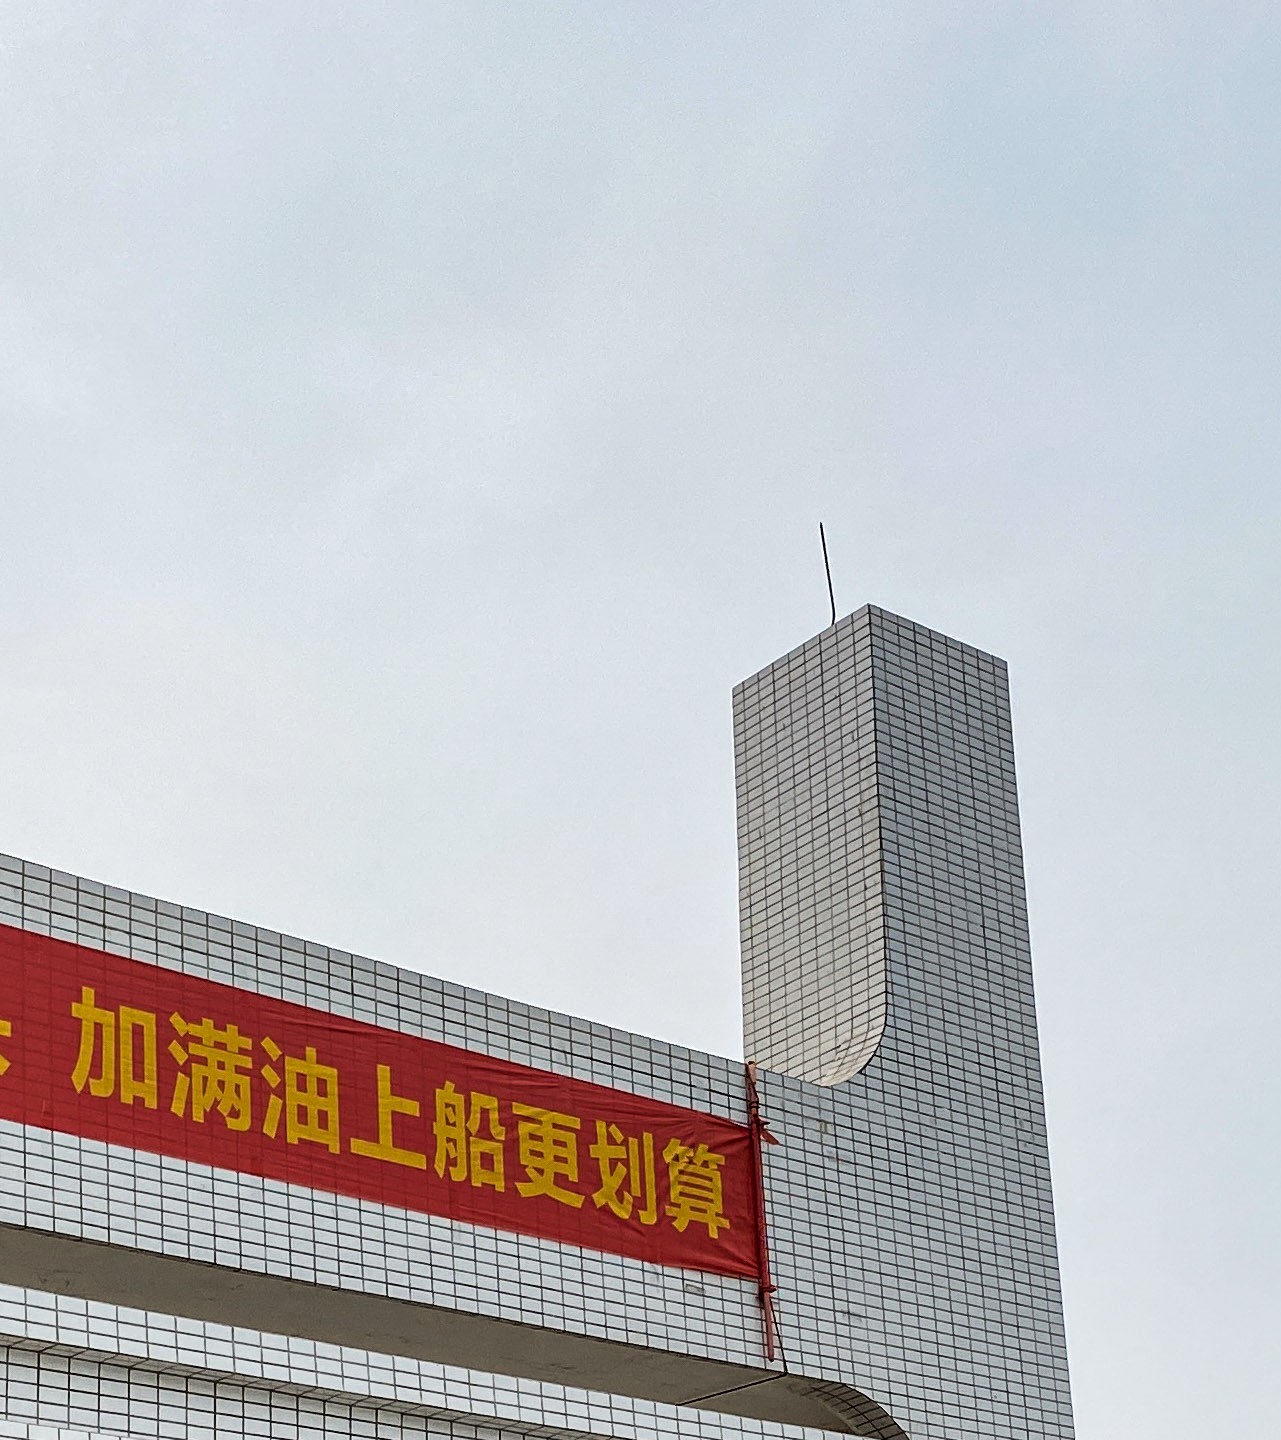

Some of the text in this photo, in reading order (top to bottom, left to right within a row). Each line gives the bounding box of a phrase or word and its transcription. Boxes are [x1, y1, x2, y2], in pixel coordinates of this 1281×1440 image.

[71, 986, 732, 1240] 加满油上船更划算
